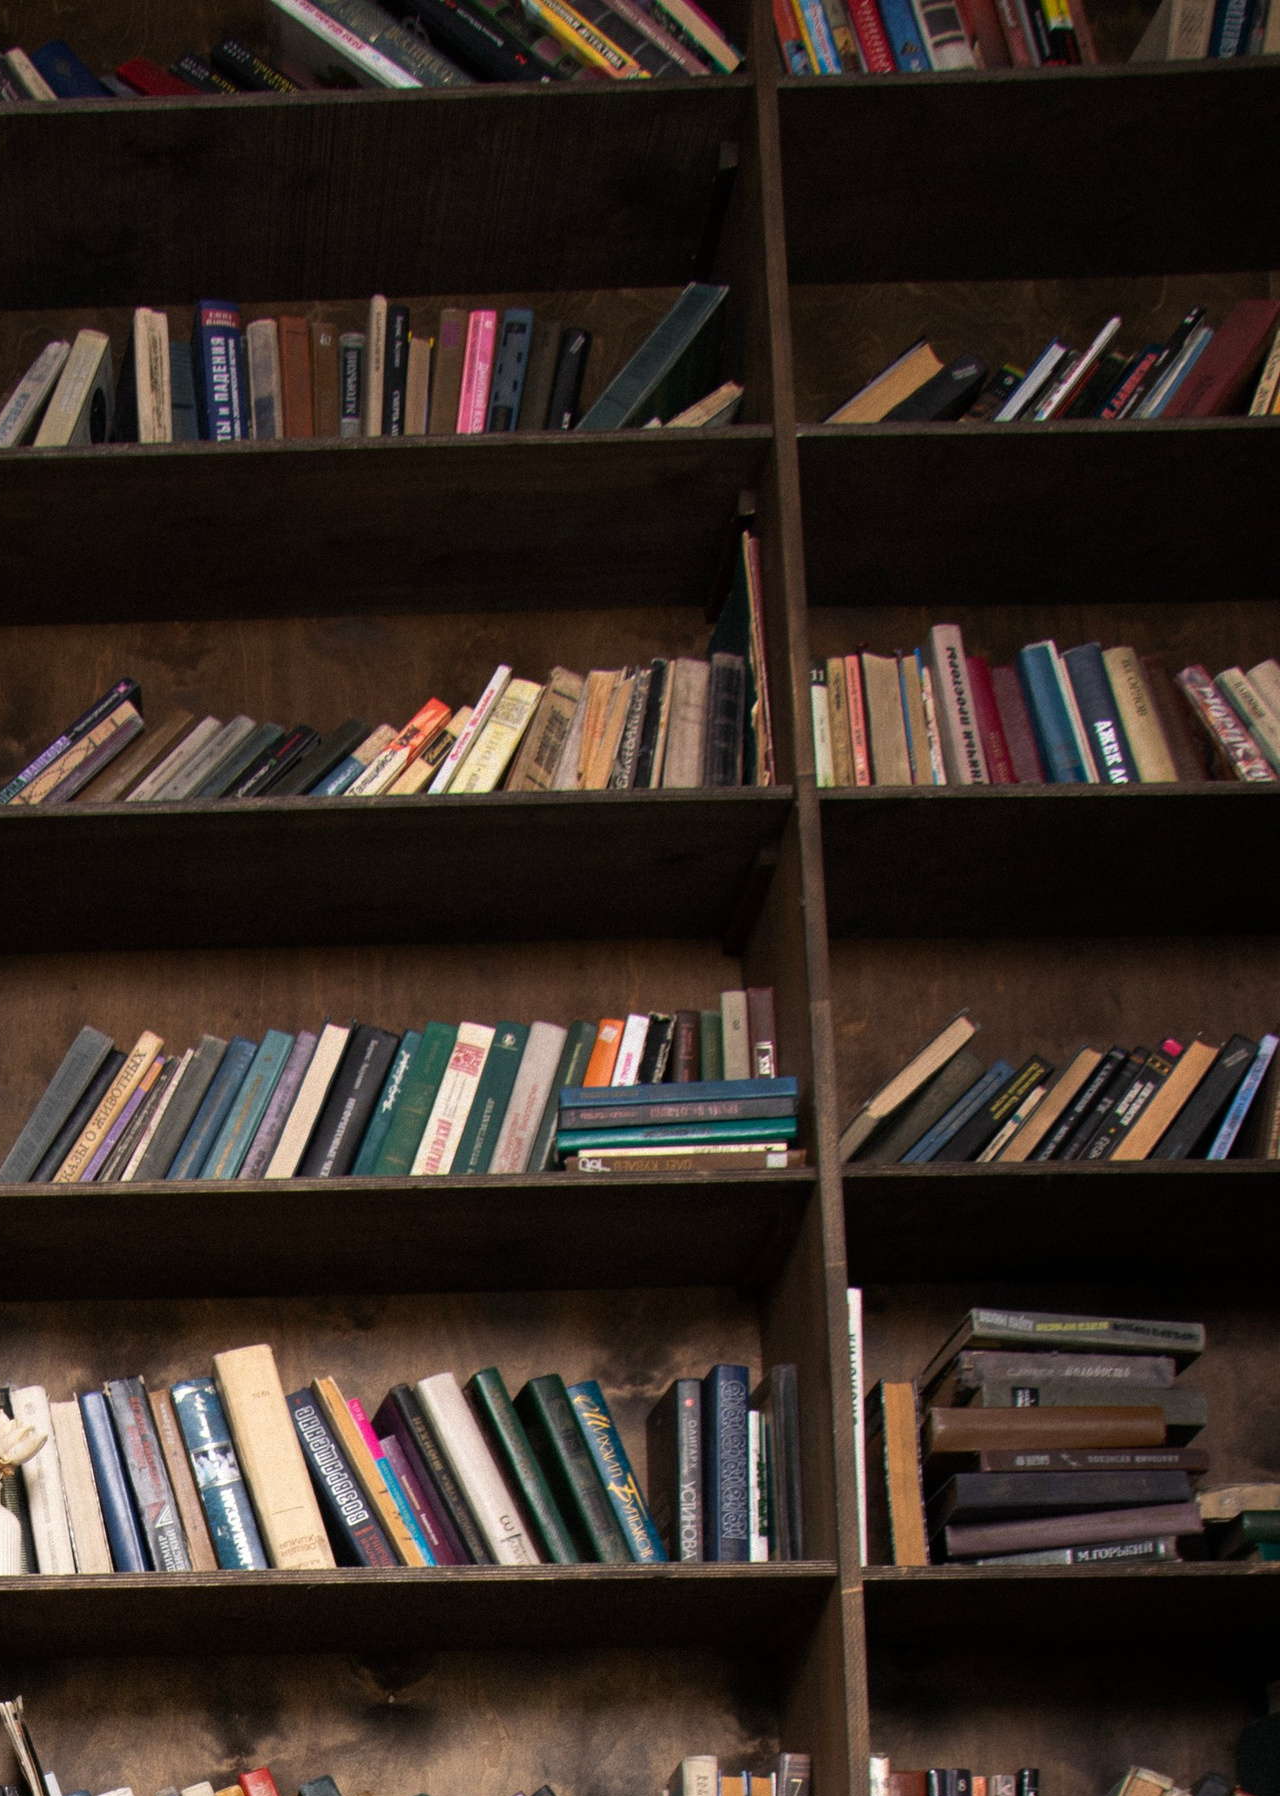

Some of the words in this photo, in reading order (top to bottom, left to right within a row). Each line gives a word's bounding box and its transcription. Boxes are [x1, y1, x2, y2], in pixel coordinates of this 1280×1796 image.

[210, 337, 228, 401] ПАДЕНИЯ
[1092, 718, 1121, 767] ДЖЕК
[347, 746, 401, 801] Таящийся
[88, 1048, 151, 1131] ЖИВОТНЫХ
[83, 1129, 99, 1144] О
[295, 1402, 369, 1526] ВОЗВРАЩЕНИЕ
[410, 1415, 444, 1471] МЮНХЕН
[678, 1480, 698, 1560] УСТИНОВА
[1076, 1542, 1153, 1562] М.ГОРЬКИЙ
